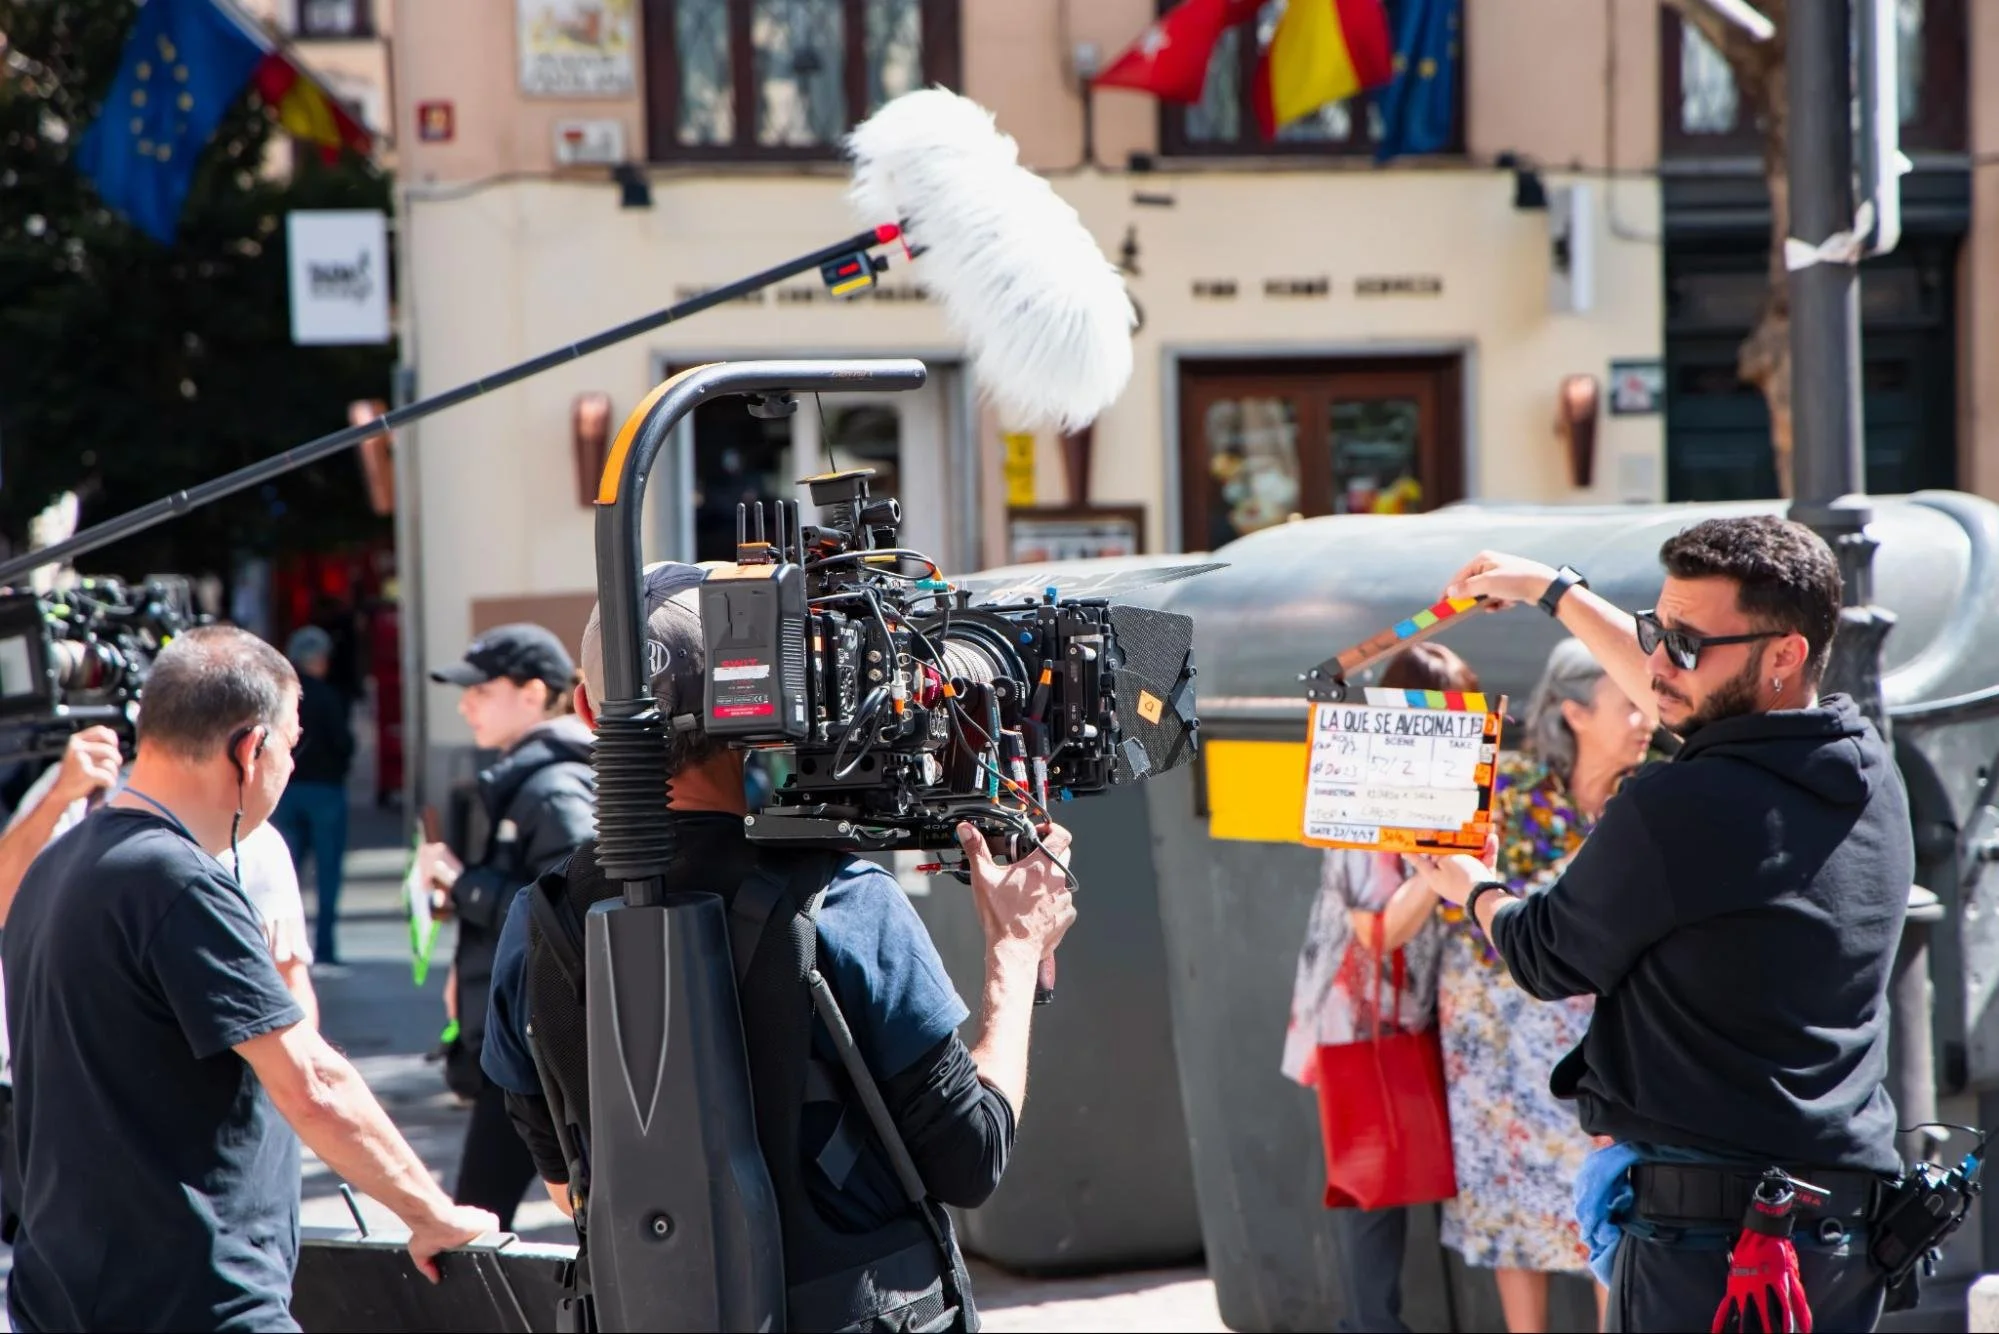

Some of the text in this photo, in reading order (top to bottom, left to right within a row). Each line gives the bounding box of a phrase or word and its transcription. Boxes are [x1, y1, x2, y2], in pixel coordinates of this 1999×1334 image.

[1320, 709, 1338, 730] LA
[1344, 710, 1368, 732] QUE
[1375, 712, 1391, 734] SE
[1395, 713, 1453, 737] AVECINA
[1385, 737, 1415, 747] SCENE
[1450, 739, 1473, 749] TAKE
